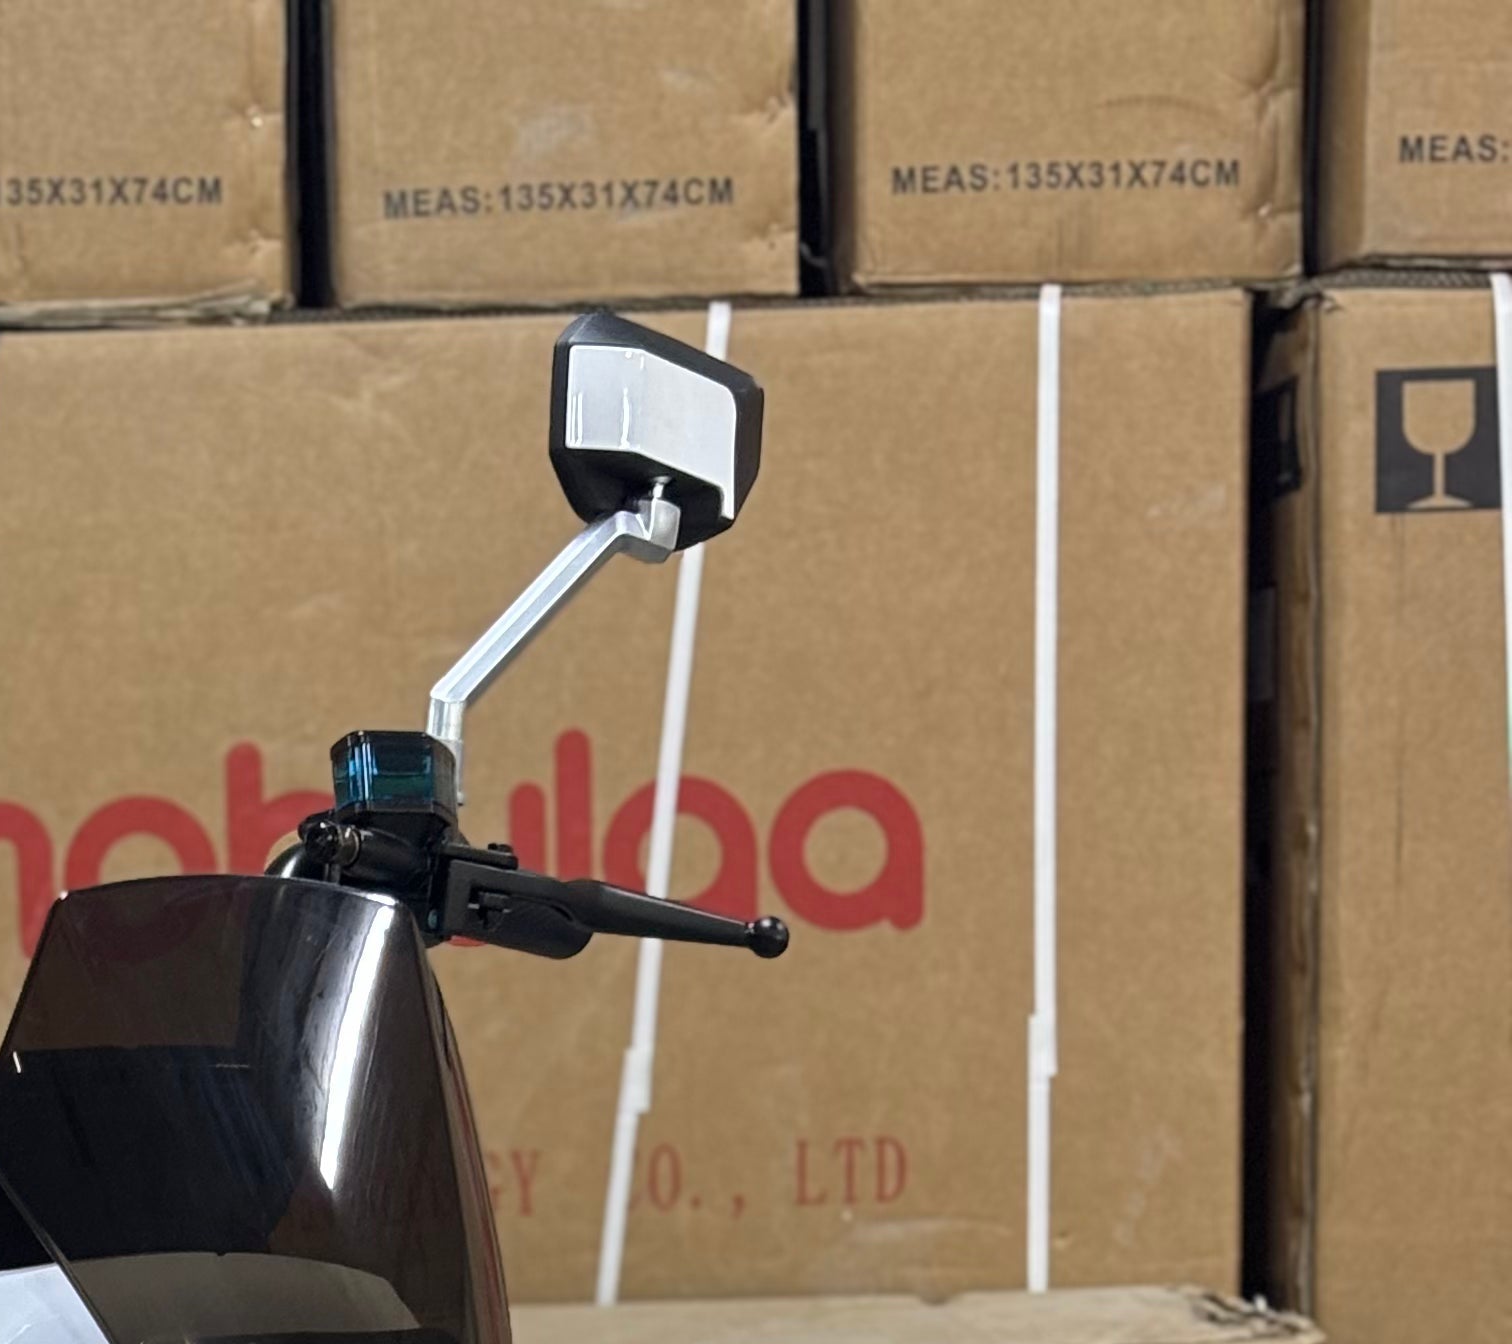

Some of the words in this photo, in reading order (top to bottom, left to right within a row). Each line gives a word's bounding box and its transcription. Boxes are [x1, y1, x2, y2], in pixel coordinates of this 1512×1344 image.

[892, 159, 1240, 194] MEAS:135X31X74CM
[383, 177, 733, 218] MEAS:135X31X74CM
[794, 1136, 908, 1207] LTD
